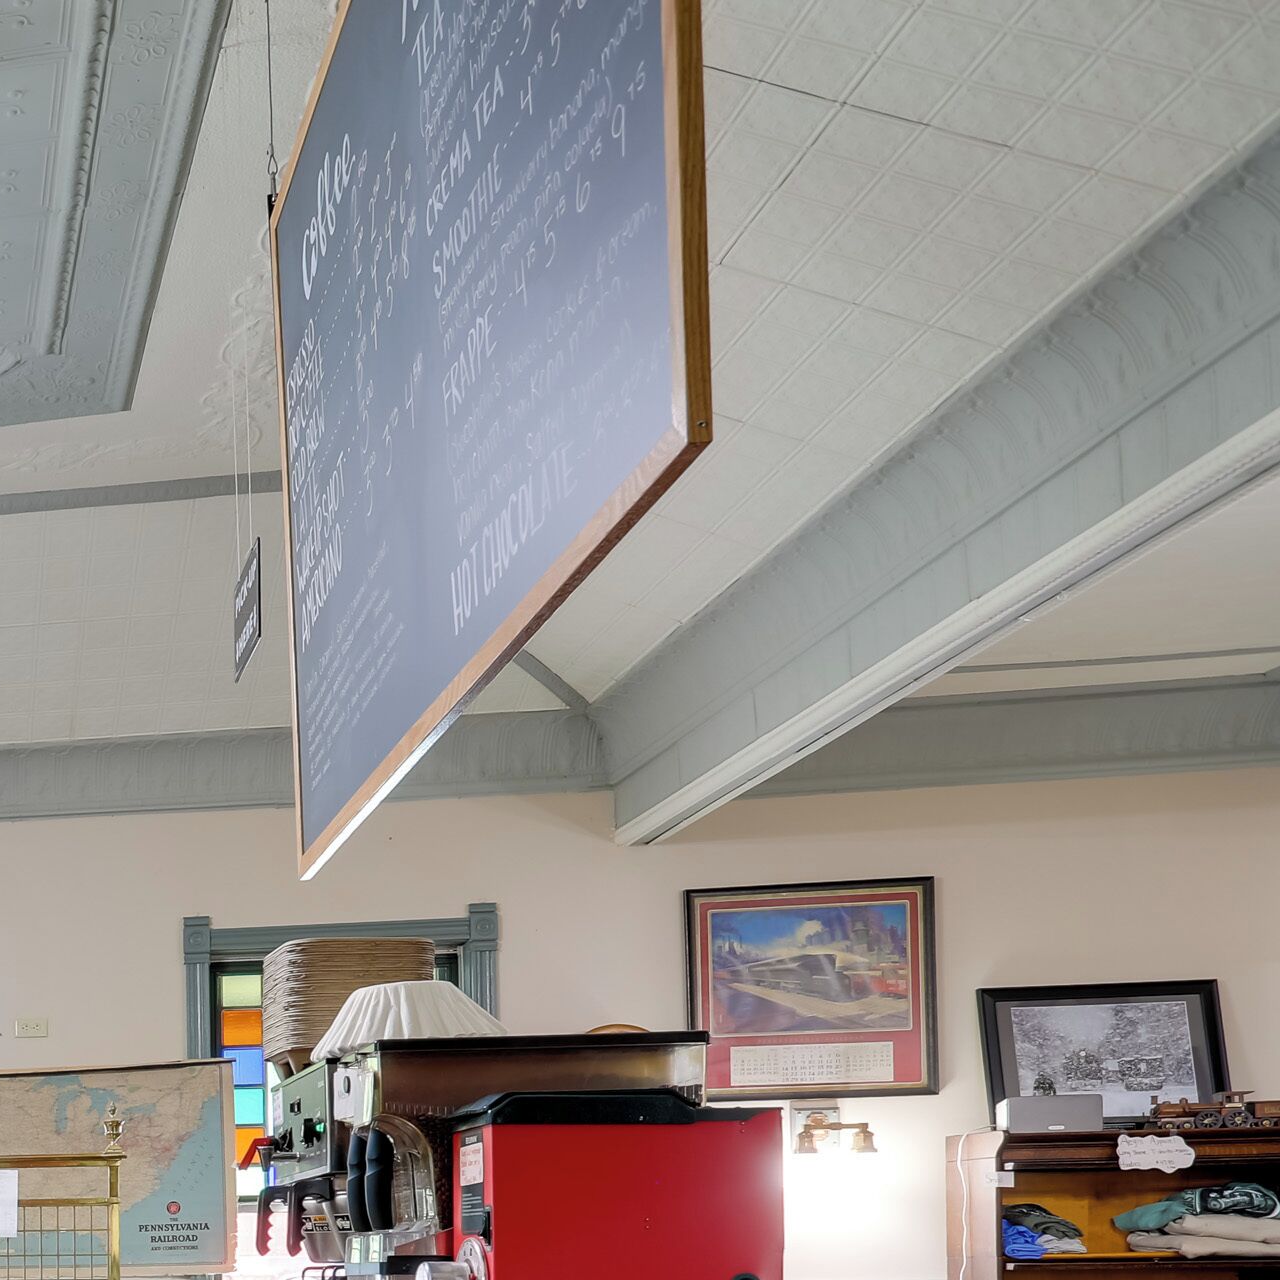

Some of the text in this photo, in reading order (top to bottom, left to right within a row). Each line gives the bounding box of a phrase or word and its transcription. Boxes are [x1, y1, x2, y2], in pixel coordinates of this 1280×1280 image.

[412, 4, 444, 86] TEA
[426, 131, 470, 235] CREMA
[472, 66, 503, 140] TEA
[302, 136, 354, 297] Coffee
[432, 147, 500, 297] SMOOTHIE
[286, 319, 314, 418] ESPRESSO
[300, 336, 323, 427] COFFEE
[442, 292, 495, 423] FRAPPE
[291, 446, 305, 501] COLD
[305, 395, 324, 466] BREW
[322, 451, 344, 537] SHOT
[294, 460, 319, 551] LATTE
[451, 441, 578, 633] HOT CHOCOLATE
[302, 525, 341, 650] AMERICANO
[138, 1222, 210, 1232] PENNSYLVANIA
[150, 1234, 199, 1243] RAILROAD
